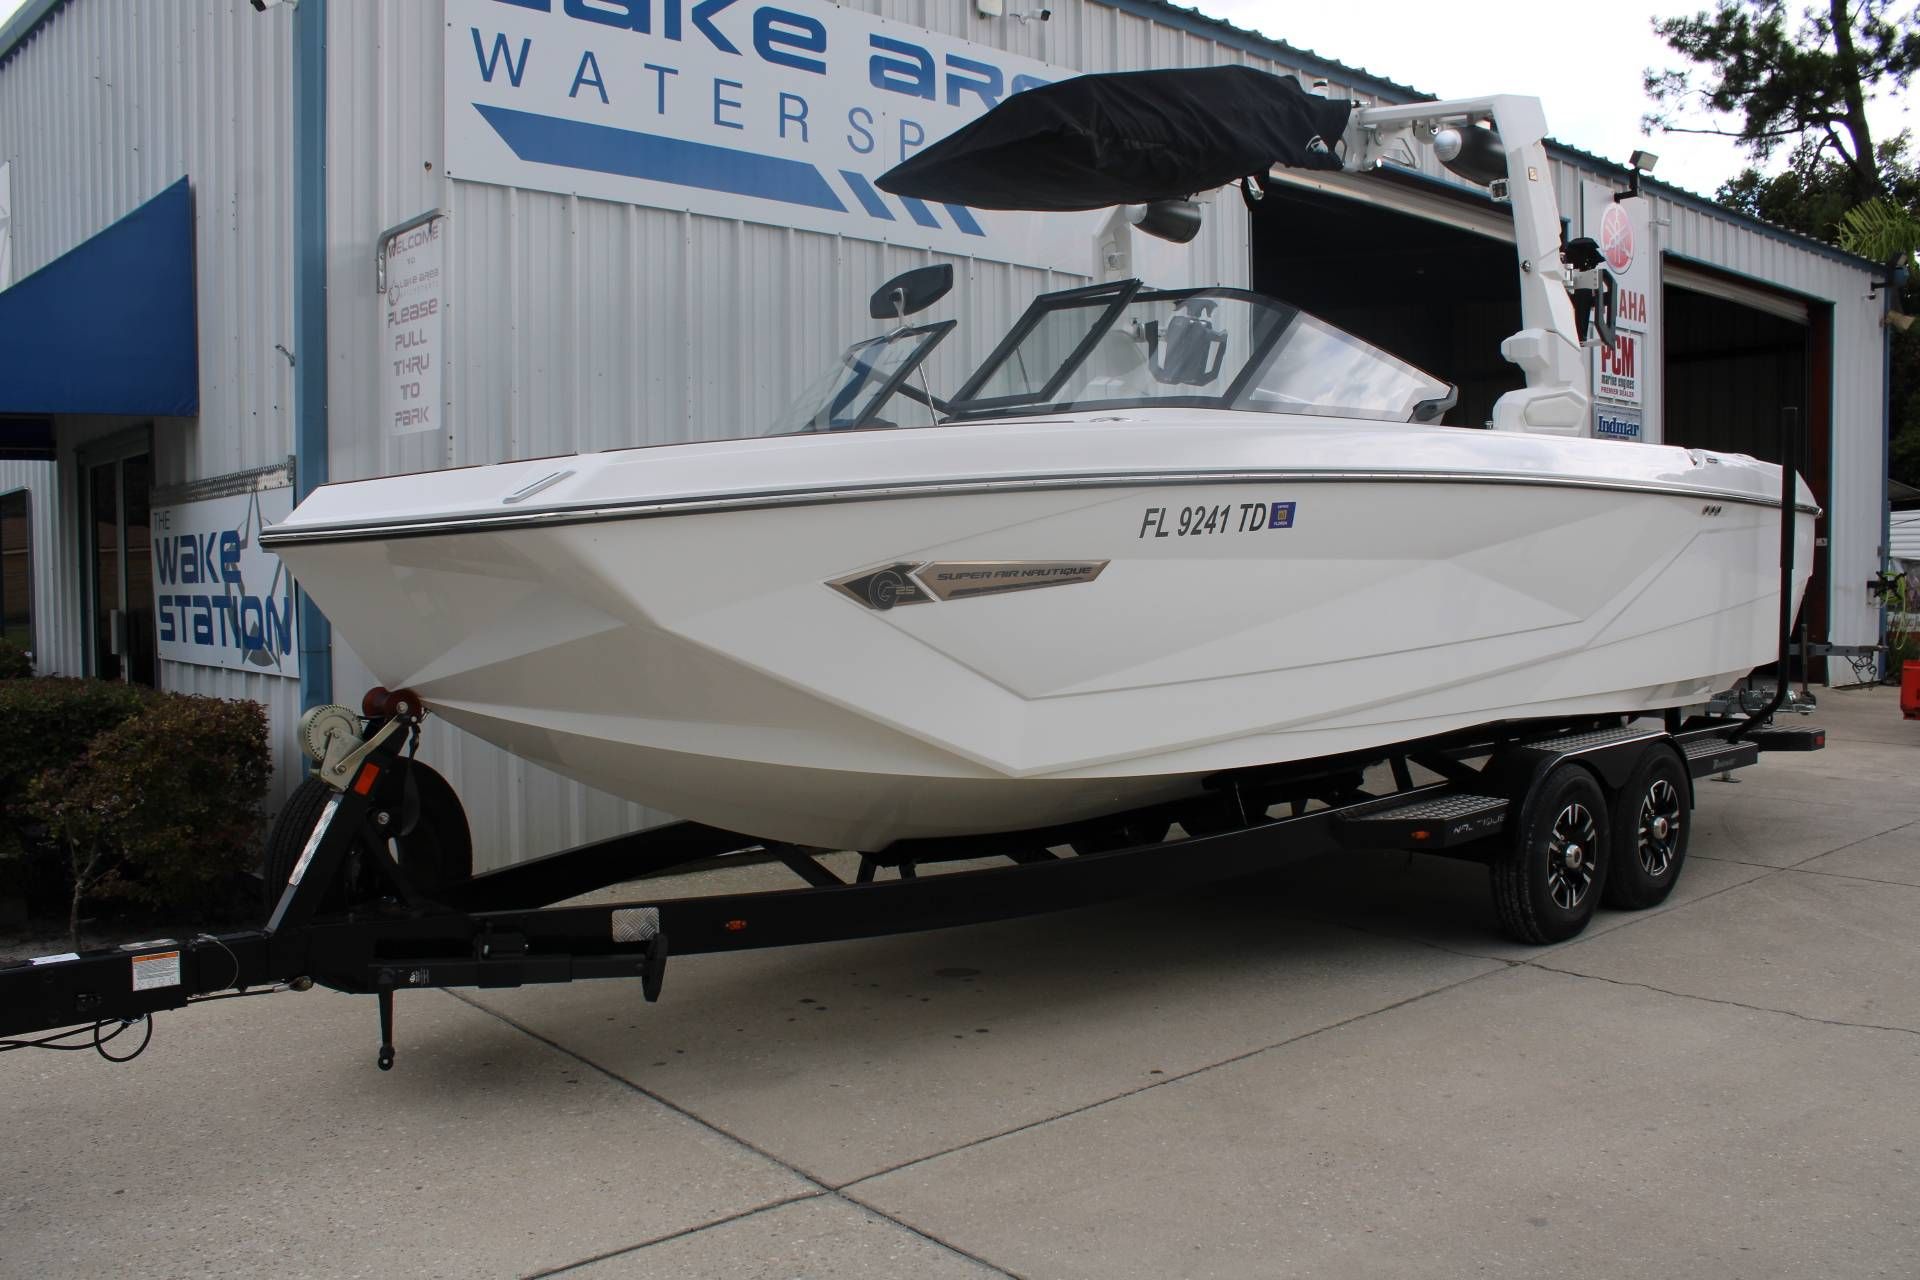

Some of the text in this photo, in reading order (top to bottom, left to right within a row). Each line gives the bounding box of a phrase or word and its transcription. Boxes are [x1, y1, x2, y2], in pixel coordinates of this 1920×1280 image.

[471, 27, 925, 162] WATERSP
[388, 225, 439, 259] WELCOME
[395, 328, 428, 351] PULL
[393, 352, 430, 377] THRU
[1601, 335, 1635, 378] PCM
[400, 382, 420, 401] TO
[1598, 415, 1640, 437] Indmar
[154, 510, 171, 530] THE
[1139, 502, 1267, 539] FL 9241 TD
[936, 566, 1093, 581] SUPER AIR NAUTIQUE
